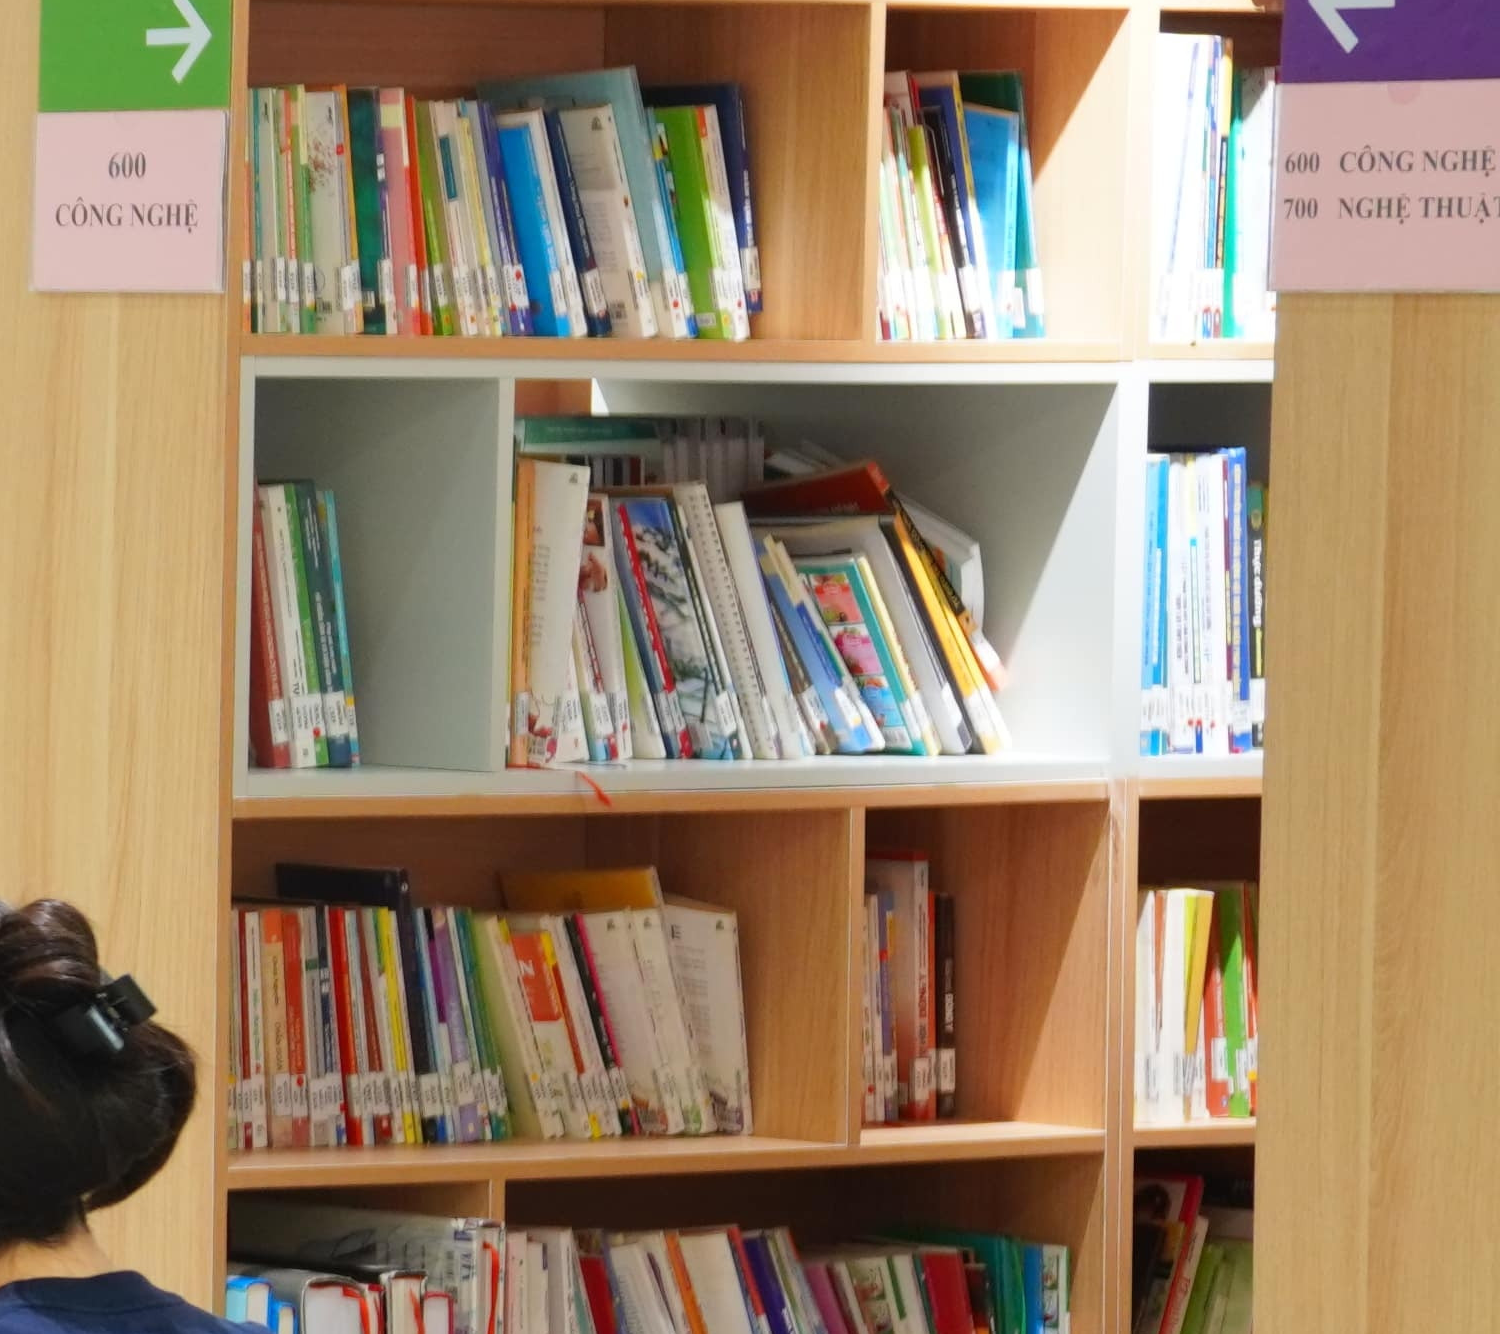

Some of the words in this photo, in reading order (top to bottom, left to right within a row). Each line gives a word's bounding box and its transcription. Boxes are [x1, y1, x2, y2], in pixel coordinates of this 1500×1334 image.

[108, 152, 146, 179] 600
[1285, 152, 1320, 174] 600
[1340, 145, 1414, 173] CÔNG
[1422, 145, 1496, 177] NGHỆ
[55, 197, 122, 228] CÔNG
[130, 198, 199, 235] NGHỆ
[1284, 197, 1318, 220] 700
[1338, 194, 1411, 224] NGHỆ
